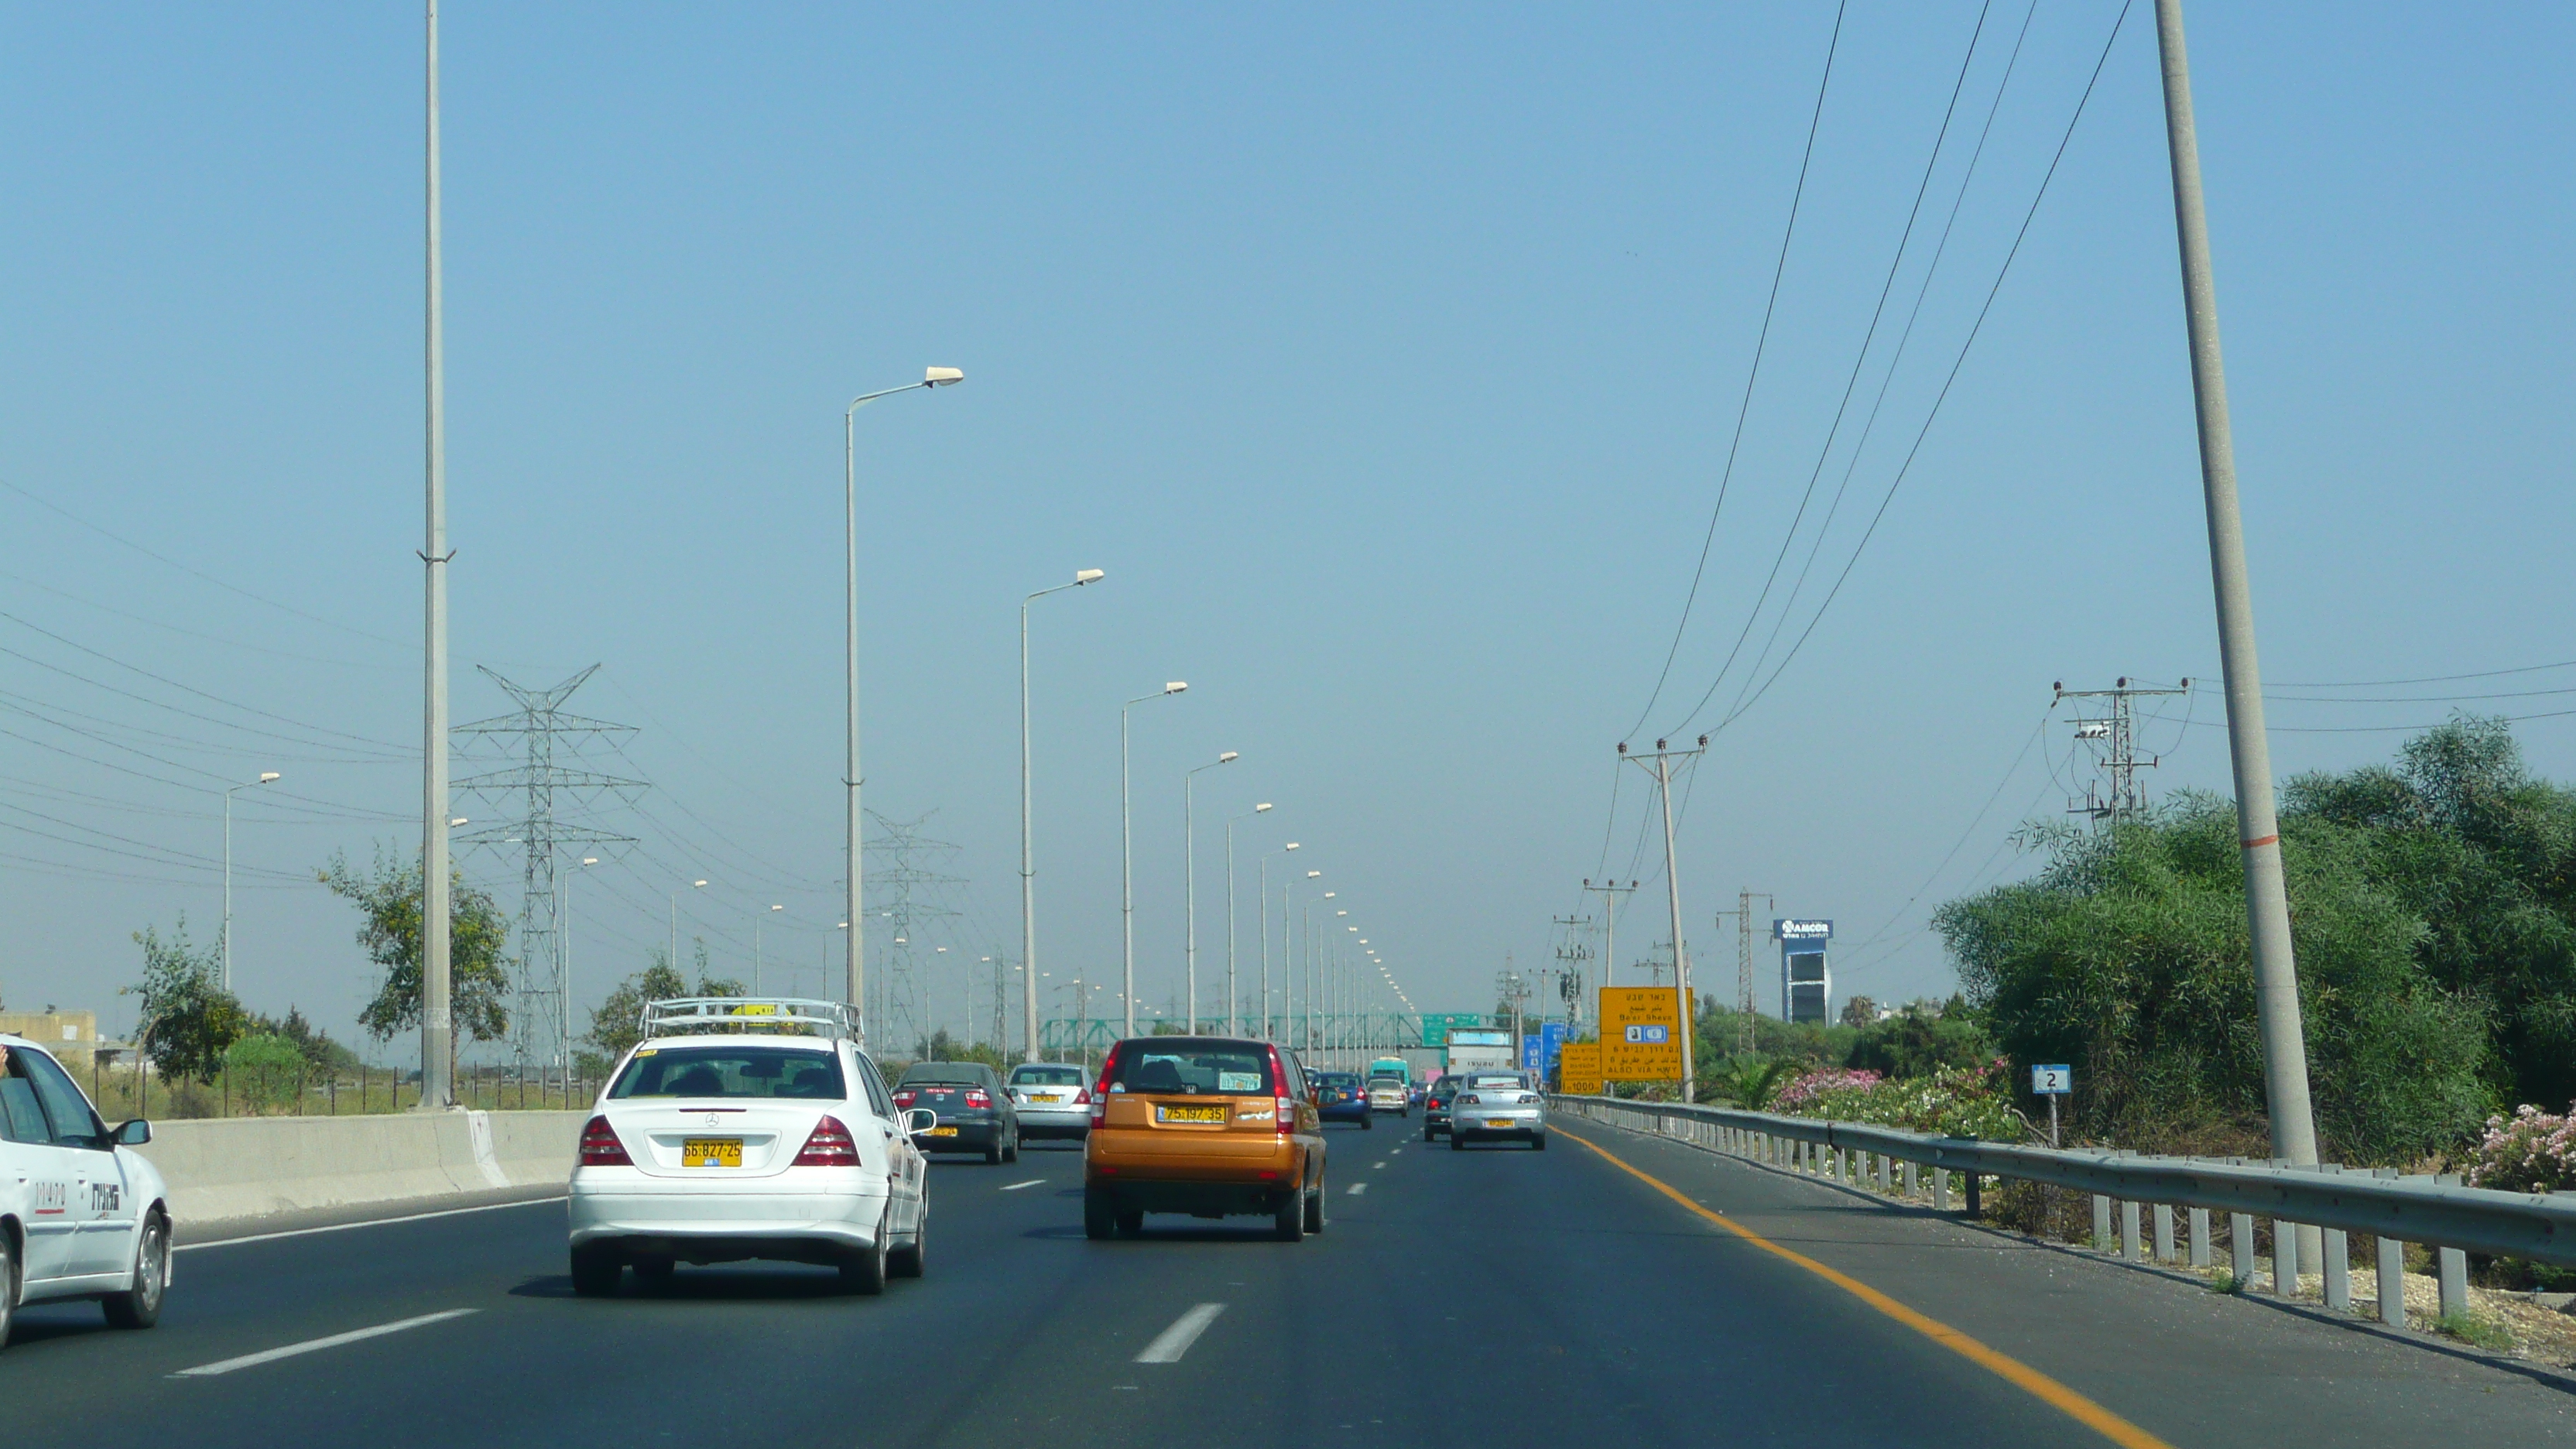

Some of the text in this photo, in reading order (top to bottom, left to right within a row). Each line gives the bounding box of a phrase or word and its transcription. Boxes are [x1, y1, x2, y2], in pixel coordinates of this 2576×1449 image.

[1793, 923, 1829, 933] AMCOR
[1649, 1046, 1663, 1054] דרך
[2047, 1073, 2056, 1087] 2
[1572, 1081, 1594, 1091] 1000
